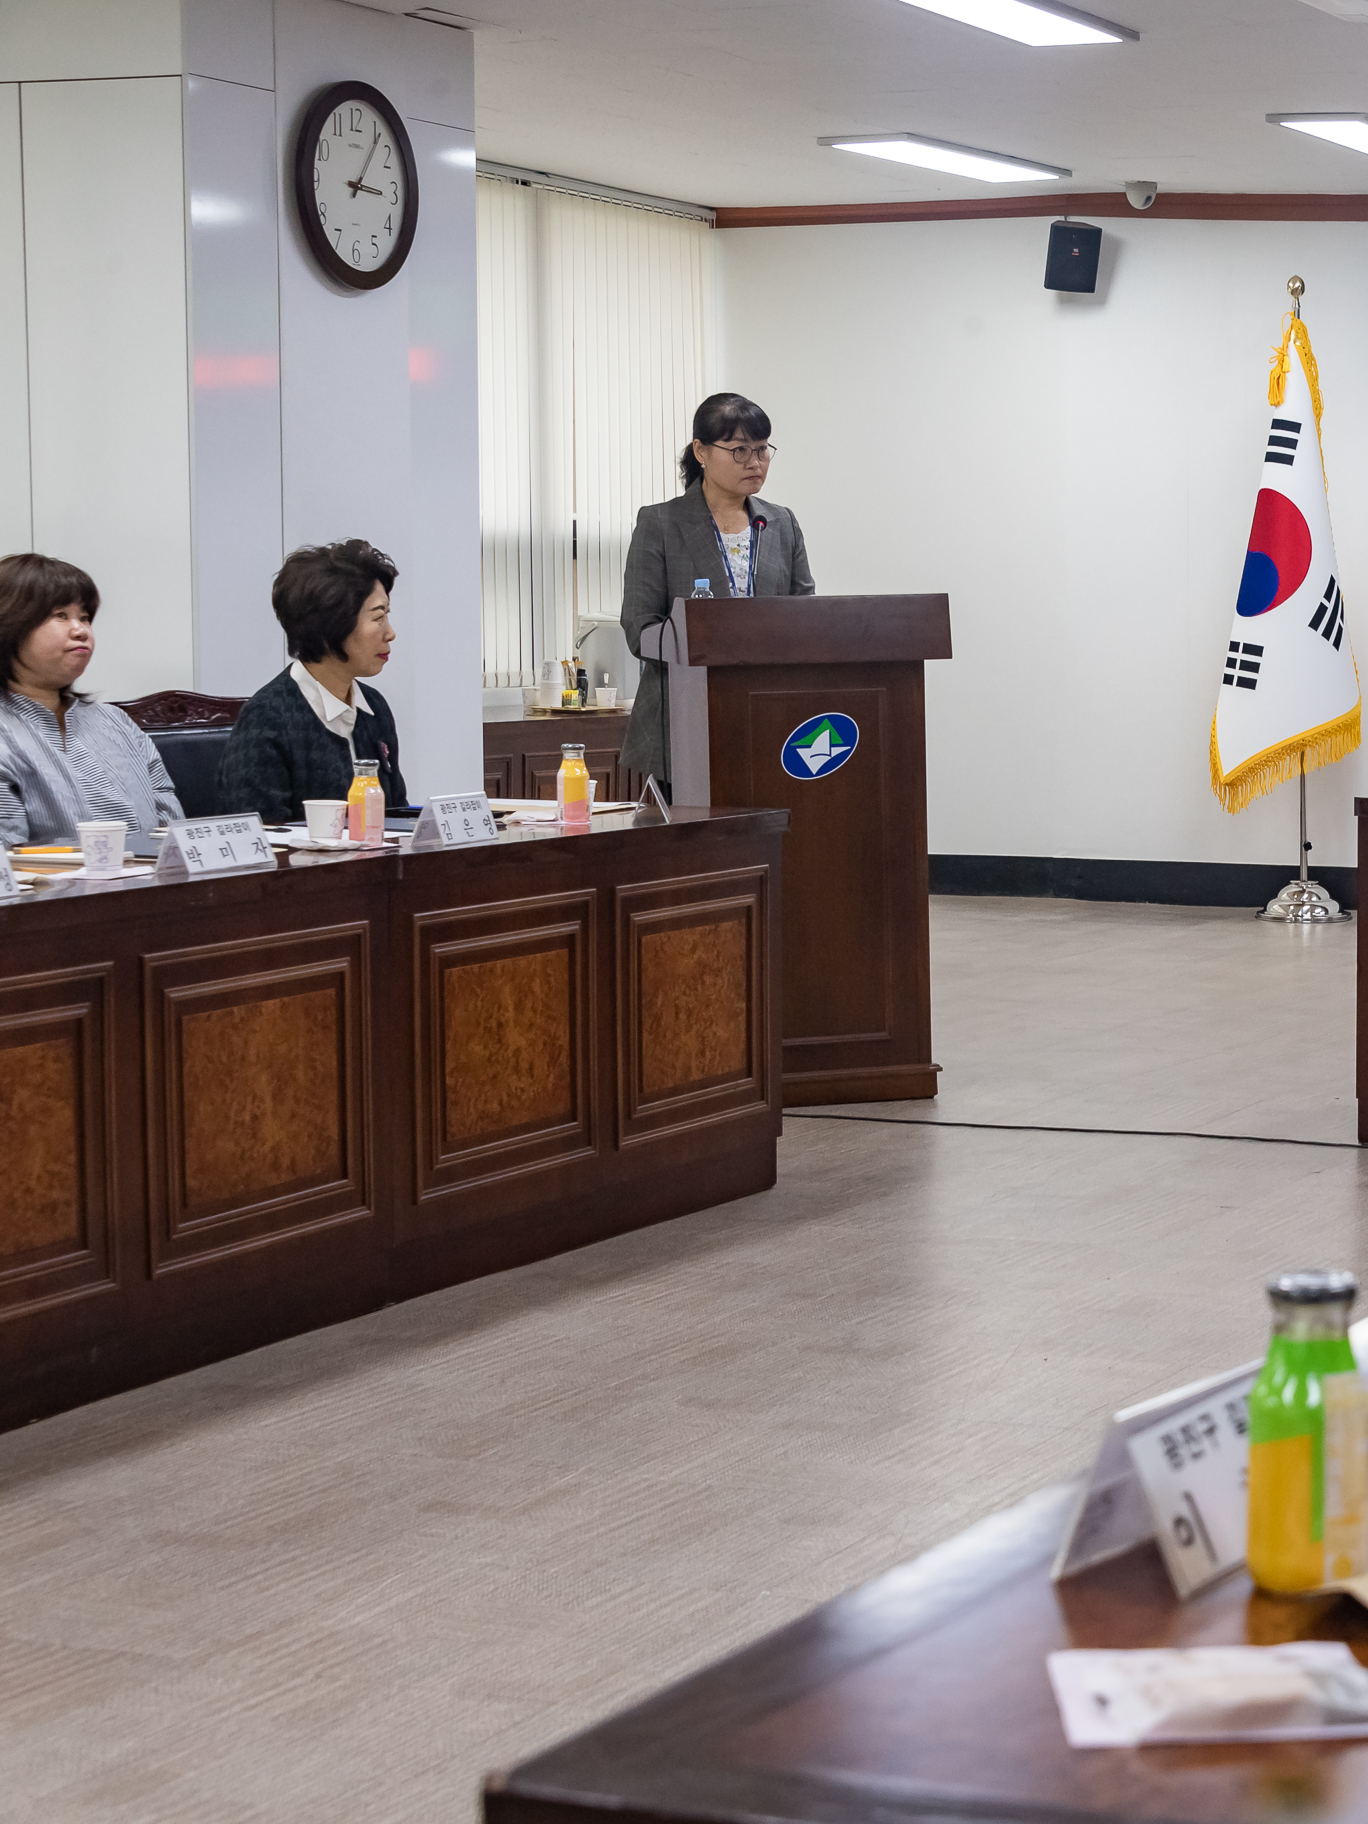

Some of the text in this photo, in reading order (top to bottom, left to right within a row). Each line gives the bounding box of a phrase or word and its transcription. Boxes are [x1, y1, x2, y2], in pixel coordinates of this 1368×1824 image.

[332, 112, 343, 137] 11
[350, 108, 362, 133] 12
[317, 138, 330, 162] 10
[383, 145, 391, 169] 2
[314, 167, 320, 190] 9
[390, 181, 399, 205] 3
[319, 202, 327, 226] 8
[384, 213, 393, 237] 4
[334, 228, 342, 250] 7
[371, 235, 379, 258] 5
[352, 240, 361, 264] 6
